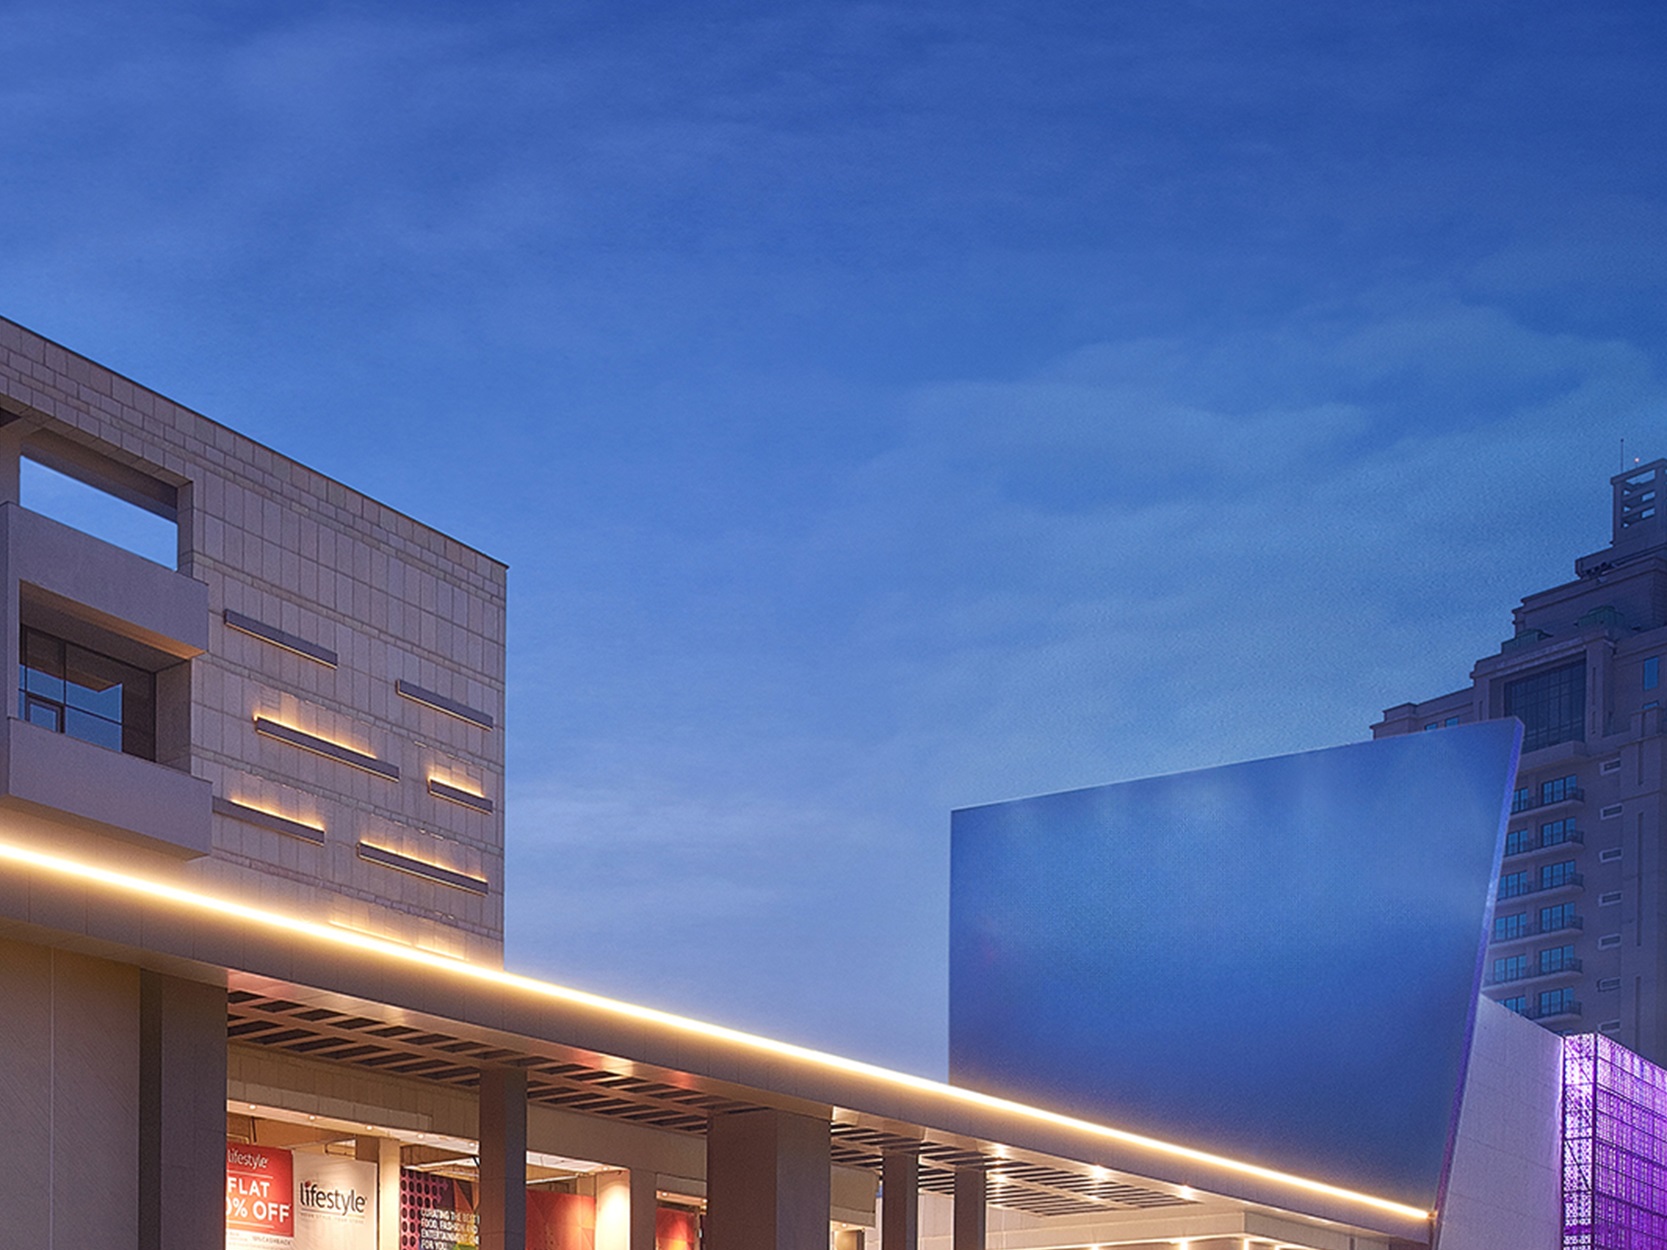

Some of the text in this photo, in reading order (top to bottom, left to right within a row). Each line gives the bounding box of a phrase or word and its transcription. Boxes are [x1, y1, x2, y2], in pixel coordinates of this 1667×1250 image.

[227, 1148, 268, 1170] lifestyle
[227, 1177, 270, 1198] FLAT
[300, 1181, 366, 1216] lifestyle
